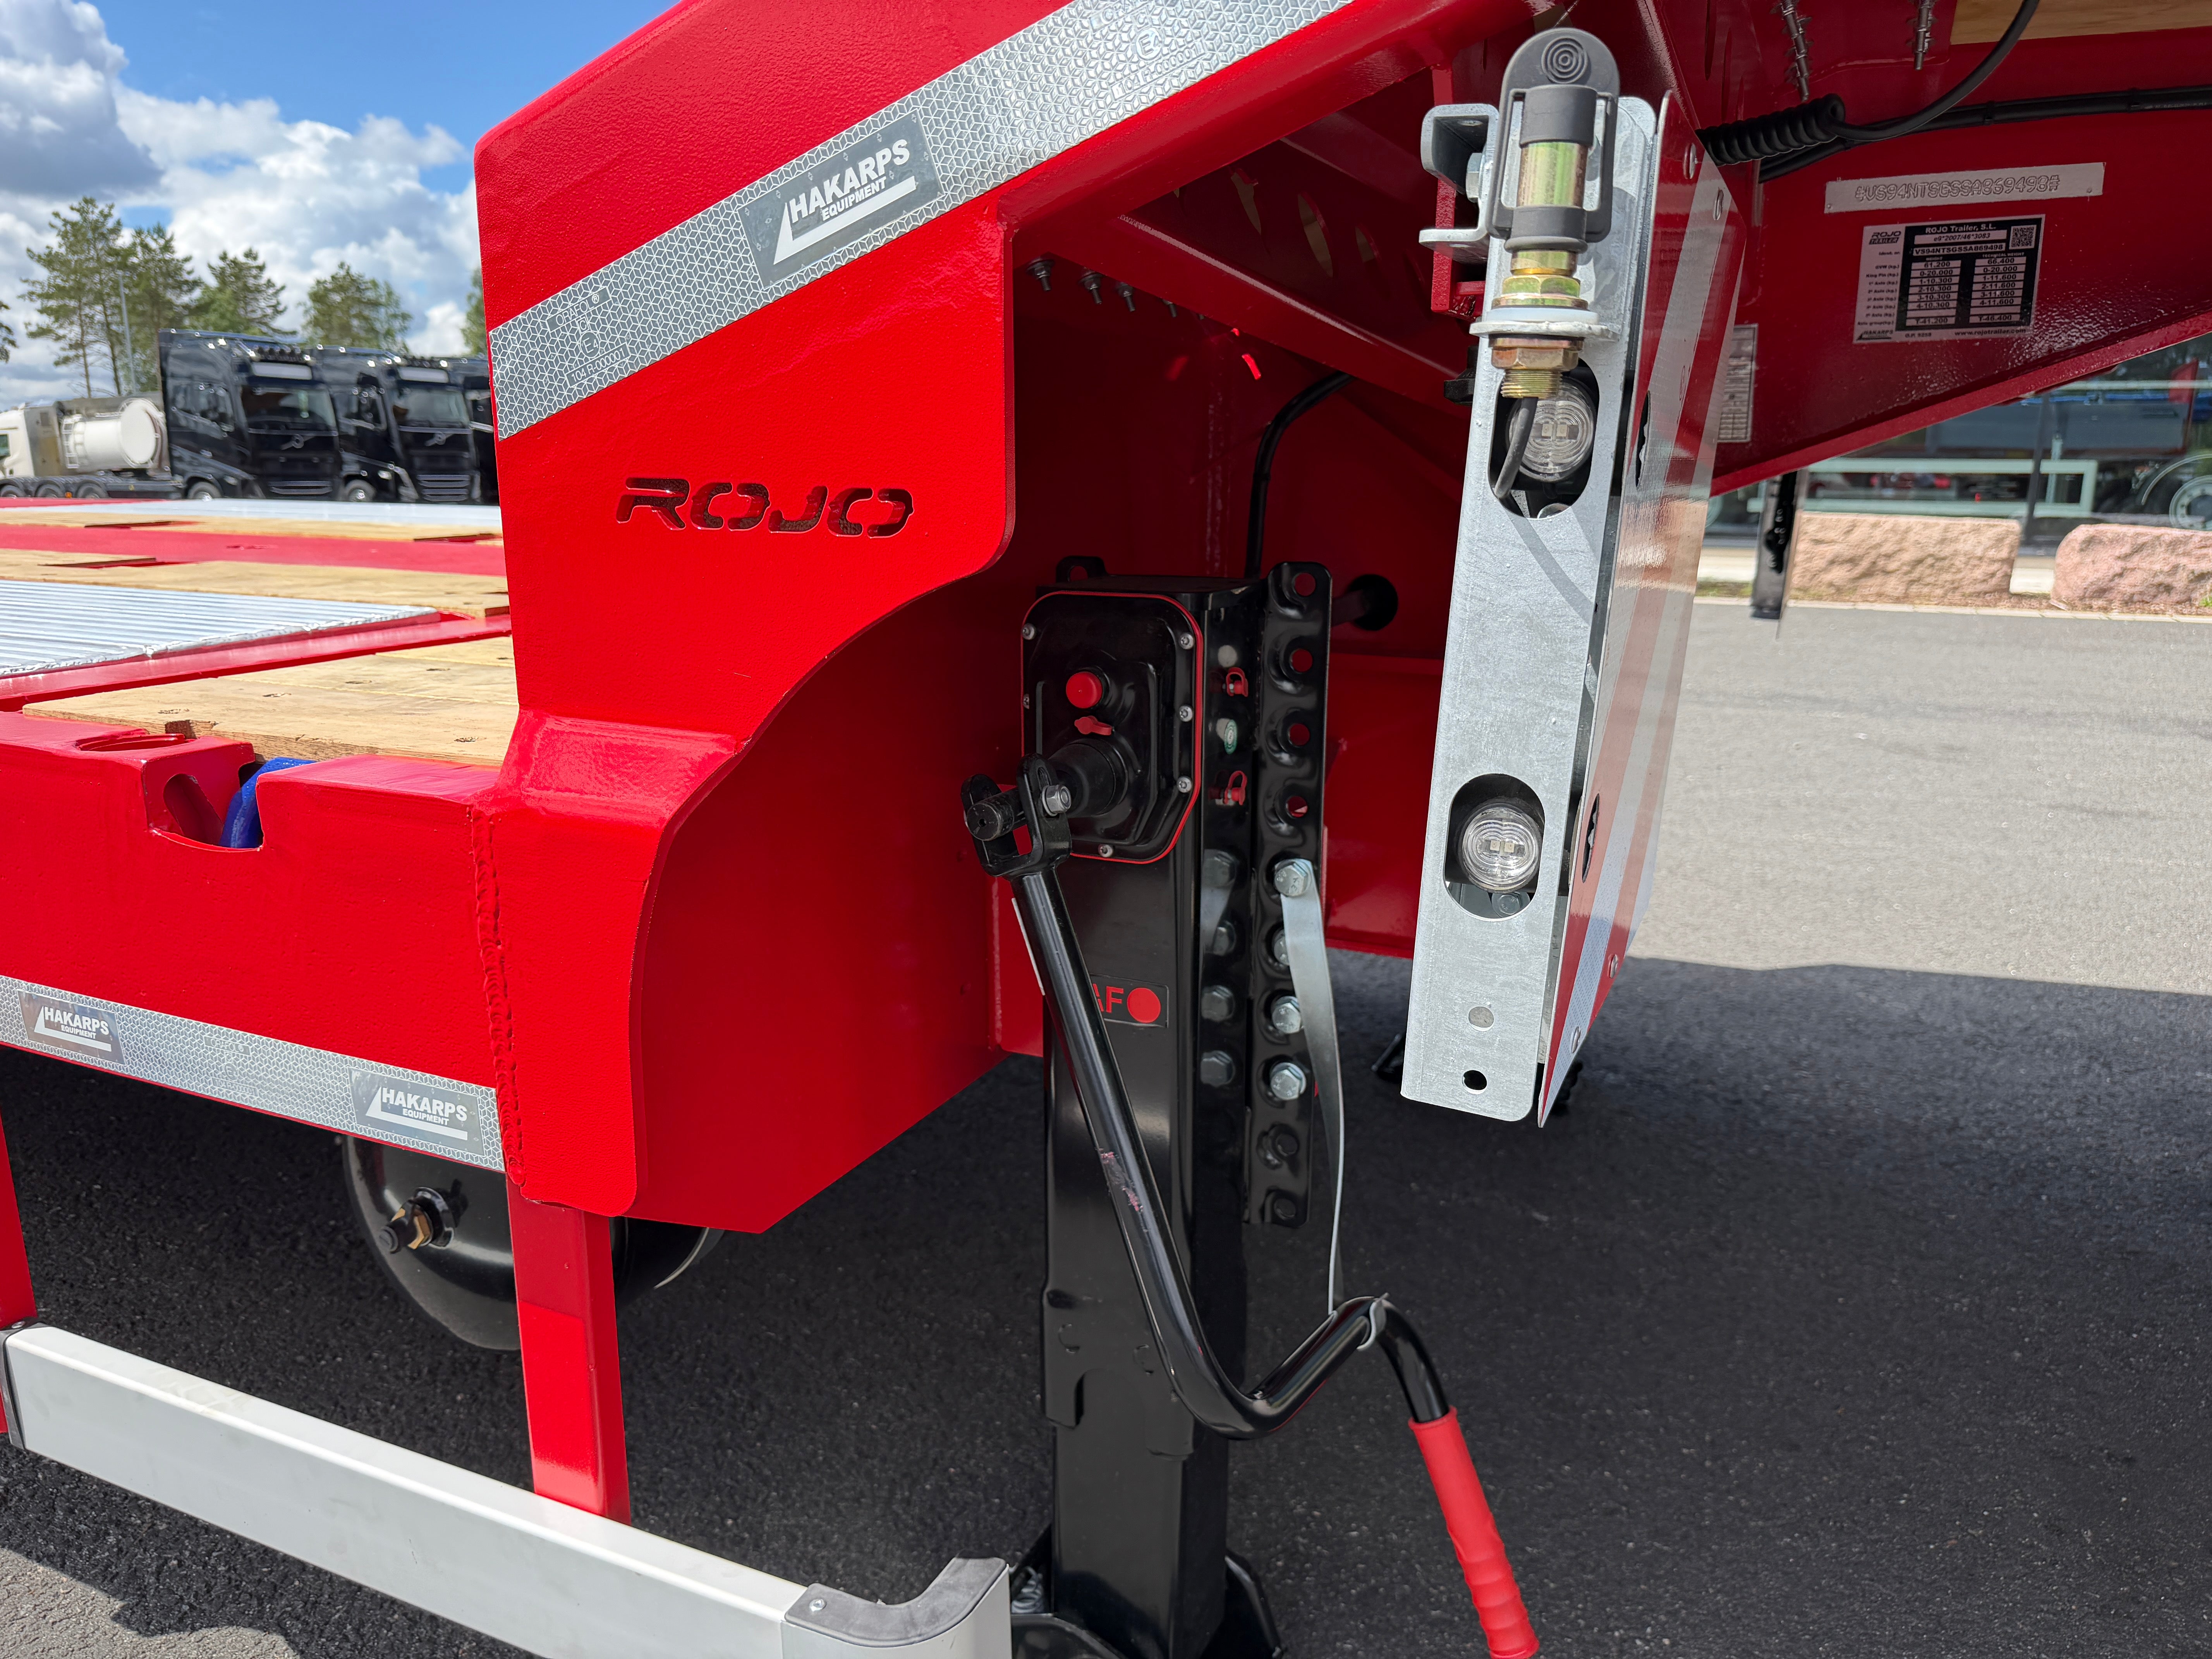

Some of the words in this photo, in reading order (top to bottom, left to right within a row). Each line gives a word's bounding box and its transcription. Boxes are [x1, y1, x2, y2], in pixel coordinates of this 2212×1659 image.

[789, 139, 910, 223] HAKARPS
[822, 176, 887, 222] EQUIPMENT
[1915, 245, 2004, 255] VS94NTSGSSA869498
[571, 368, 586, 382] 104
[587, 348, 625, 375] R-000001
[616, 477, 915, 539] ROJO
[45, 1006, 110, 1035] HAKARPS
[61, 1025, 96, 1039] EQUIPMENT
[382, 1087, 468, 1121] HAKARPS
[402, 1108, 449, 1126] EQUIPMENT
